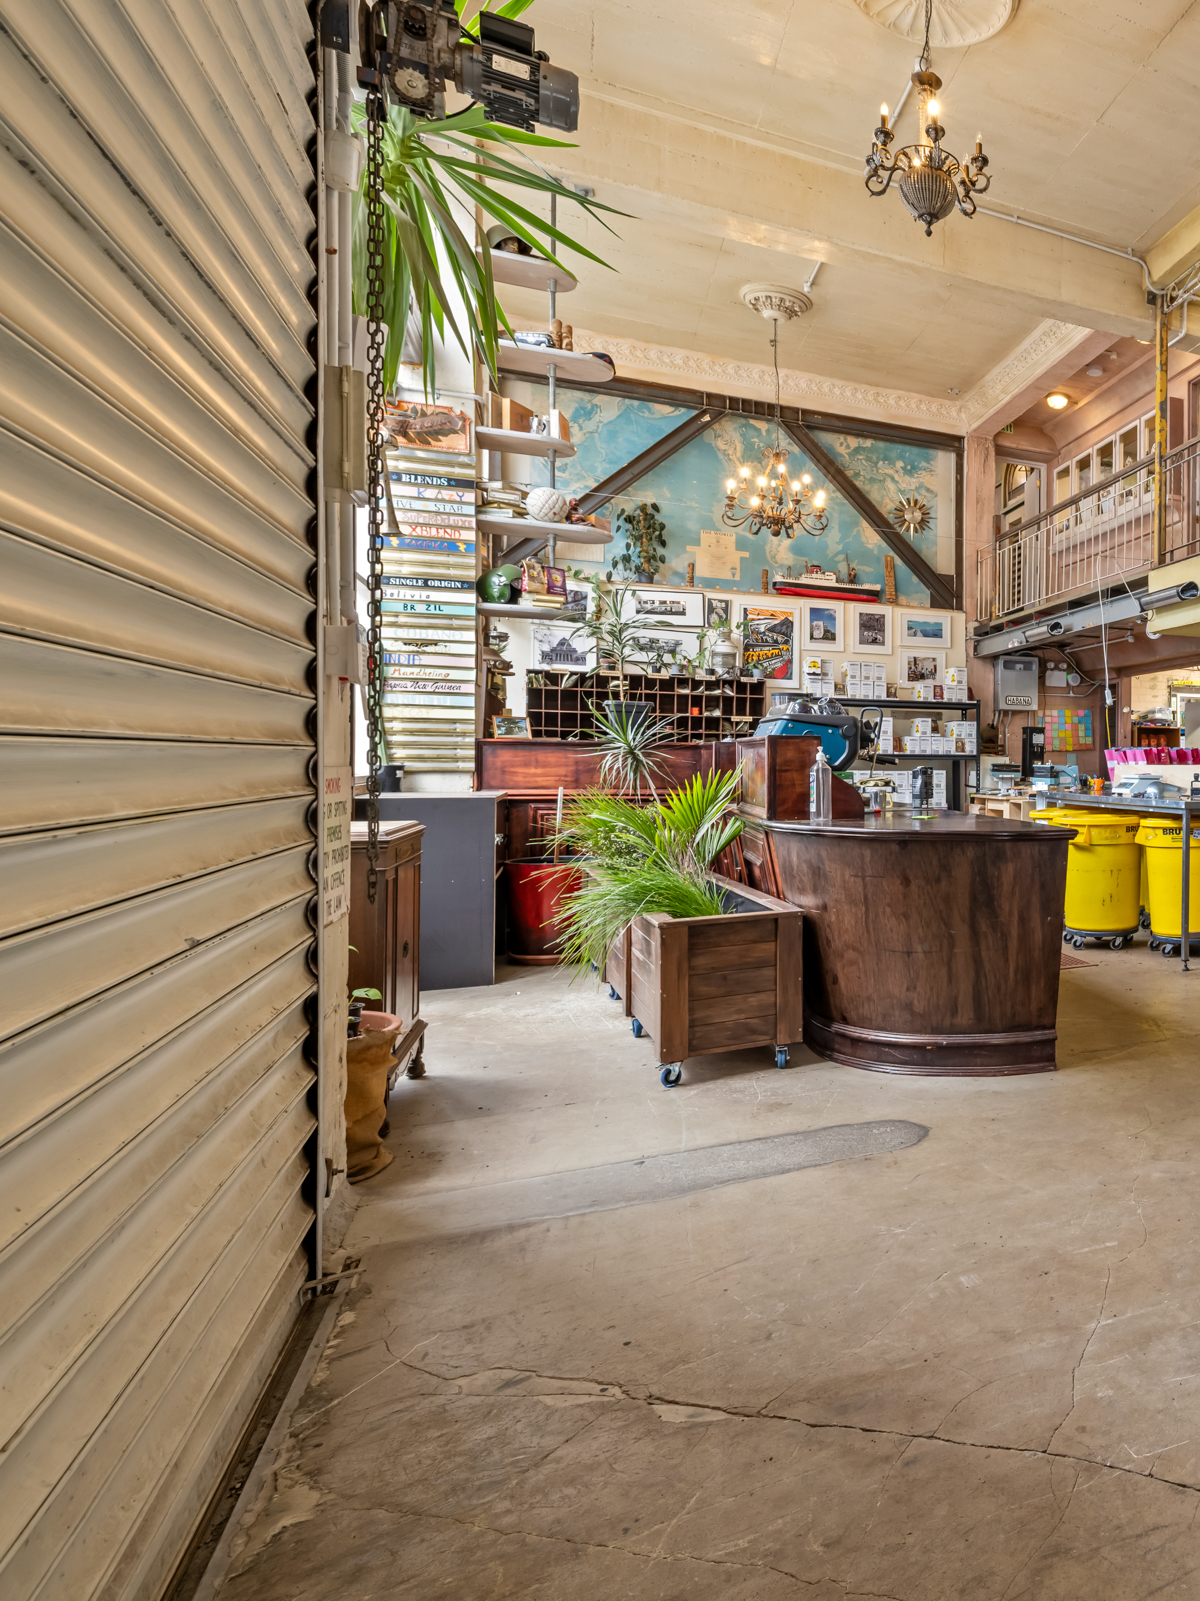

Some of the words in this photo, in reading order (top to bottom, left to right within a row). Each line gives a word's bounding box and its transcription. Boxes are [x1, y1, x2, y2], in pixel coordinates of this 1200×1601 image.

[401, 473, 448, 486] BLENDS
[393, 500, 416, 509] IVE
[434, 503, 464, 513] STAR
[408, 525, 462, 540] XBLEND
[389, 577, 425, 587] SINGLE
[427, 579, 462, 589] ORIGIN
[403, 603, 444, 612] BRAZIL
[394, 628, 464, 640] CUBANO
[384, 653, 422, 665] INDIA
[410, 680, 429, 690] New
[430, 681, 462, 692] Guinea
[1006, 696, 1032, 705] HABANA
[325, 777, 341, 794] SMOKING
[327, 802, 333, 819] OR
[334, 801, 348, 818] SPITTING
[326, 824, 342, 844] PREMISES
[1162, 828, 1194, 836] BRUE
[331, 845, 349, 866] PROHIBITED
[330, 869, 345, 890] OFFENCE
[333, 894, 342, 913] LAW
